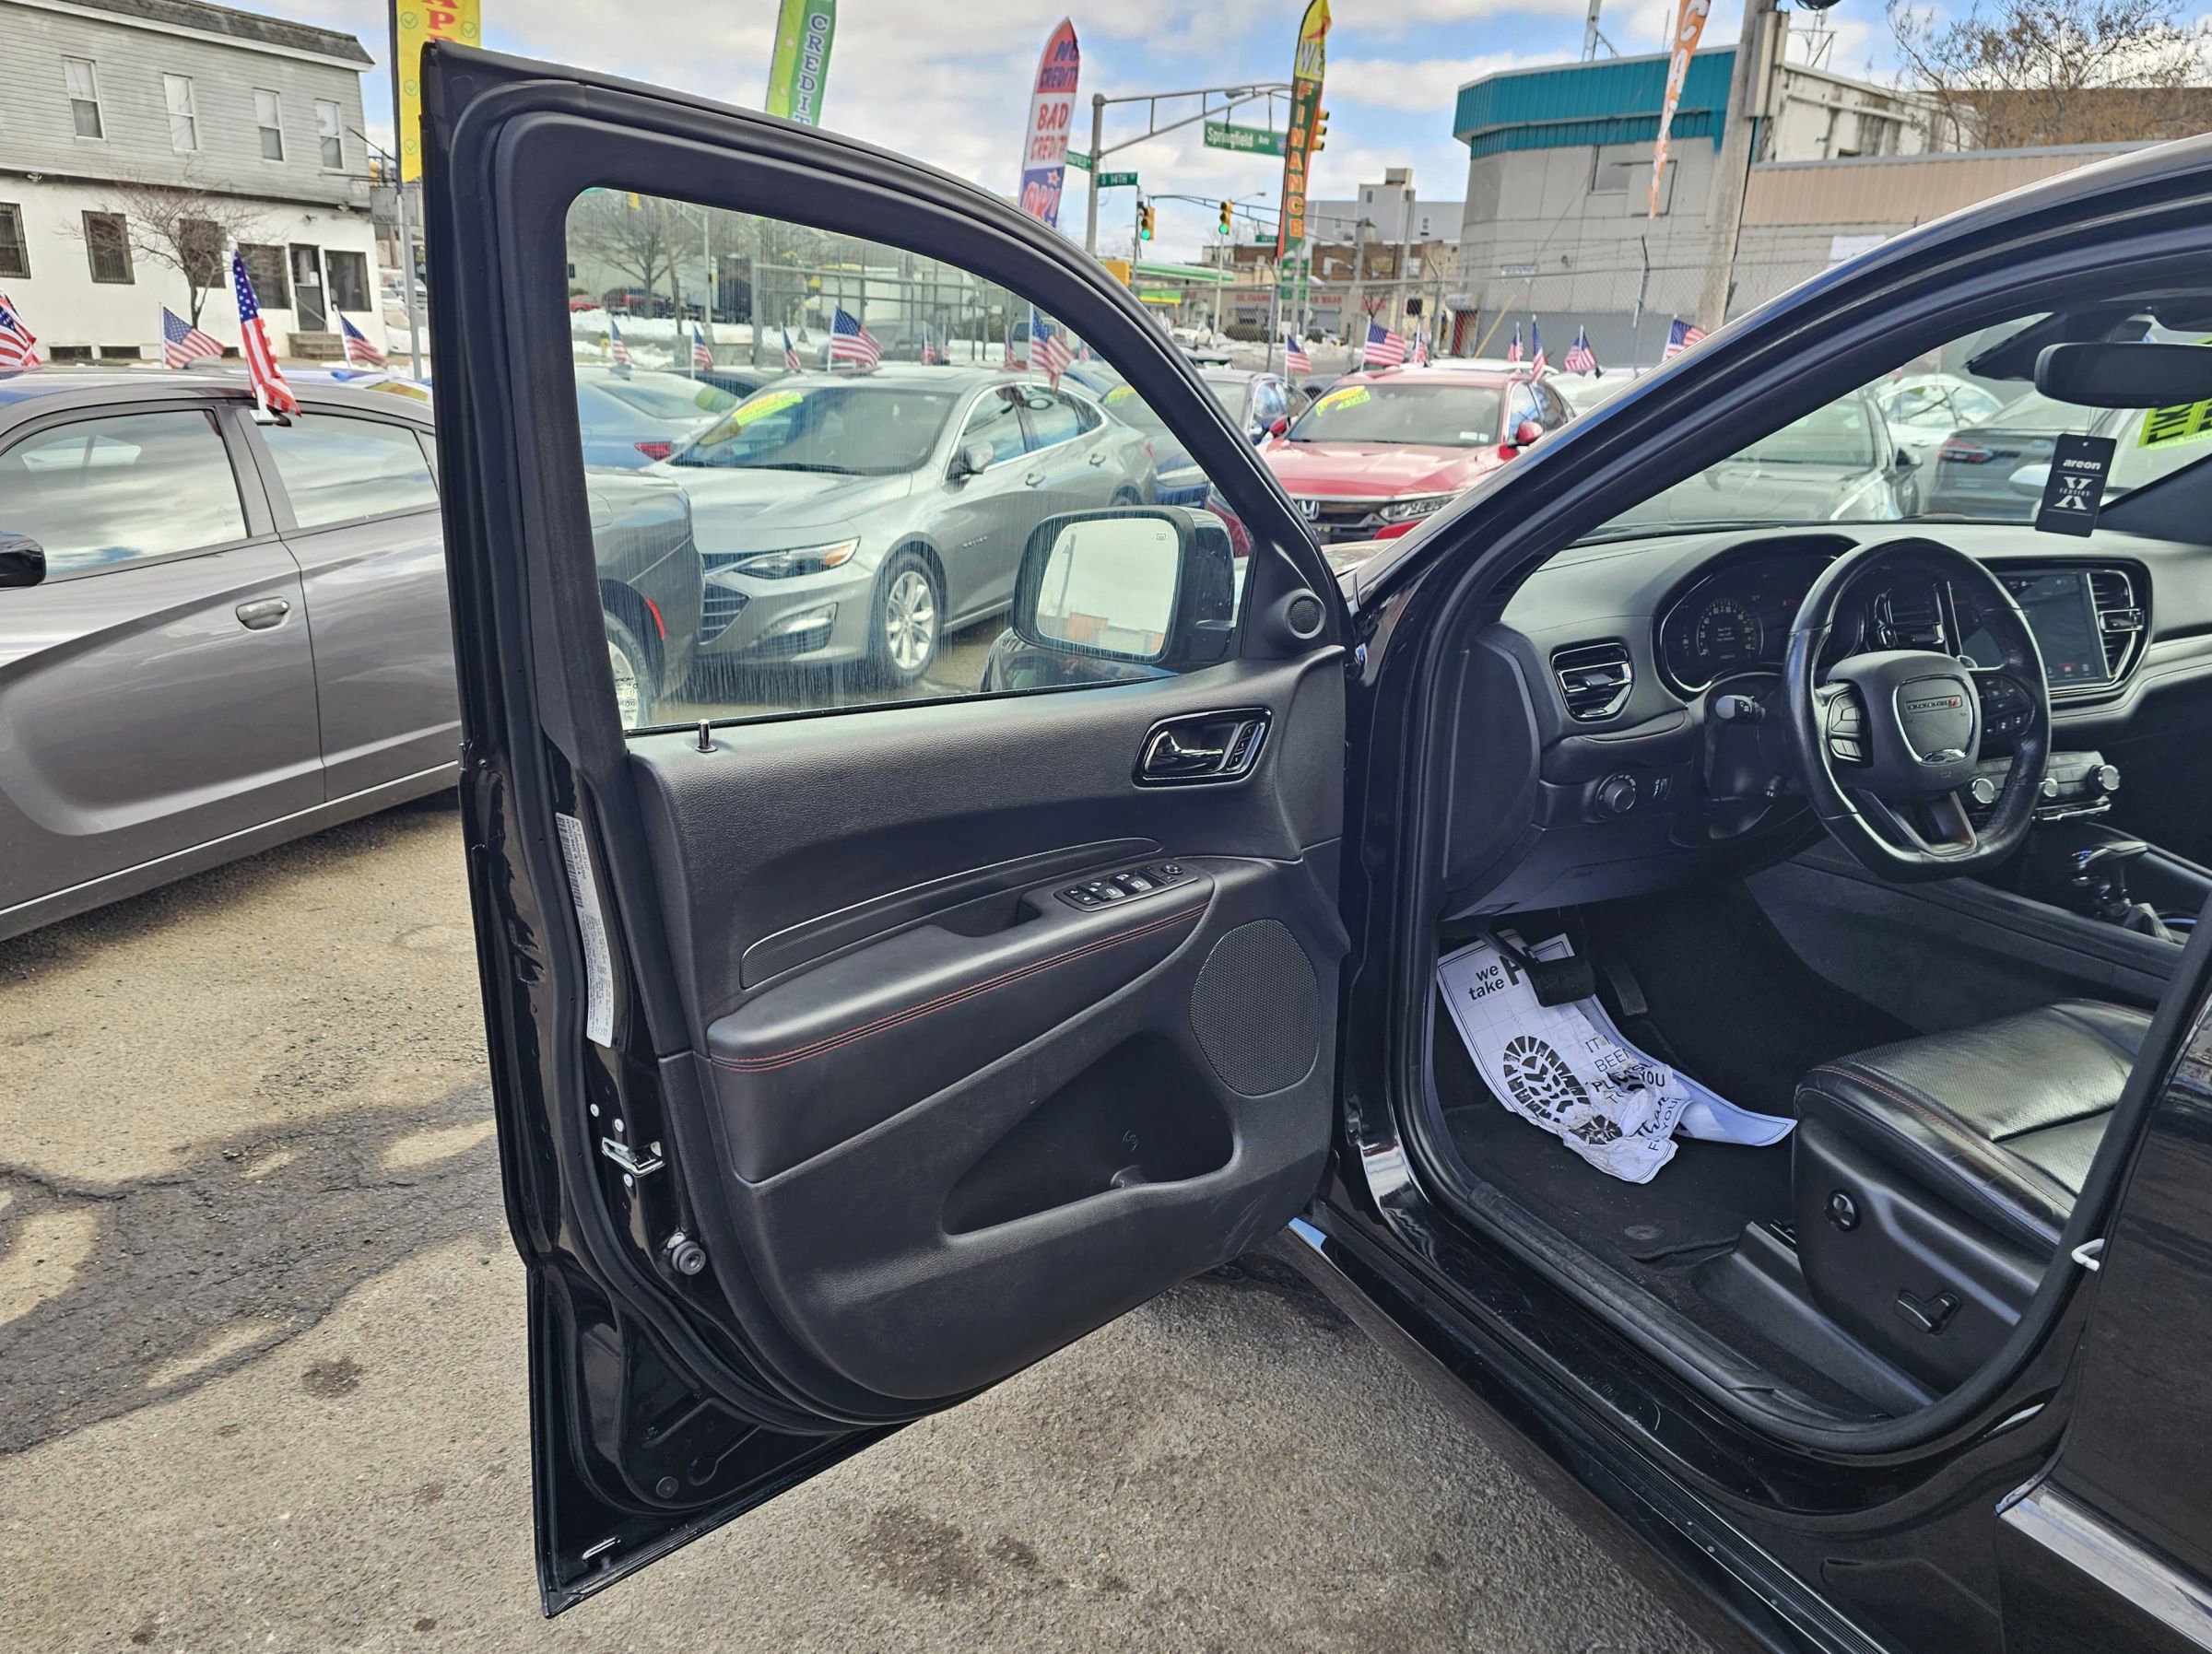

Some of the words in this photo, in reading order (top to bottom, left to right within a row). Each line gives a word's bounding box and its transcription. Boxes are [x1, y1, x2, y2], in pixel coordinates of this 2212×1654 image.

[1053, 40, 1078, 62] NO
[1298, 41, 1324, 76] WE
[794, 13, 830, 125] CREDIT
[1037, 102, 1069, 130] BAD
[1206, 125, 1253, 149] Springfield
[1288, 80, 1314, 239] FINANCE
[1100, 173, 1107, 185] S
[1111, 173, 1128, 184] 14TH
[2063, 459, 2101, 471] areon
[1476, 965, 1499, 981] we
[1468, 979, 1504, 1000] take
[1585, 1037, 1600, 1053] IT
[1641, 1071, 1665, 1087] YOU
